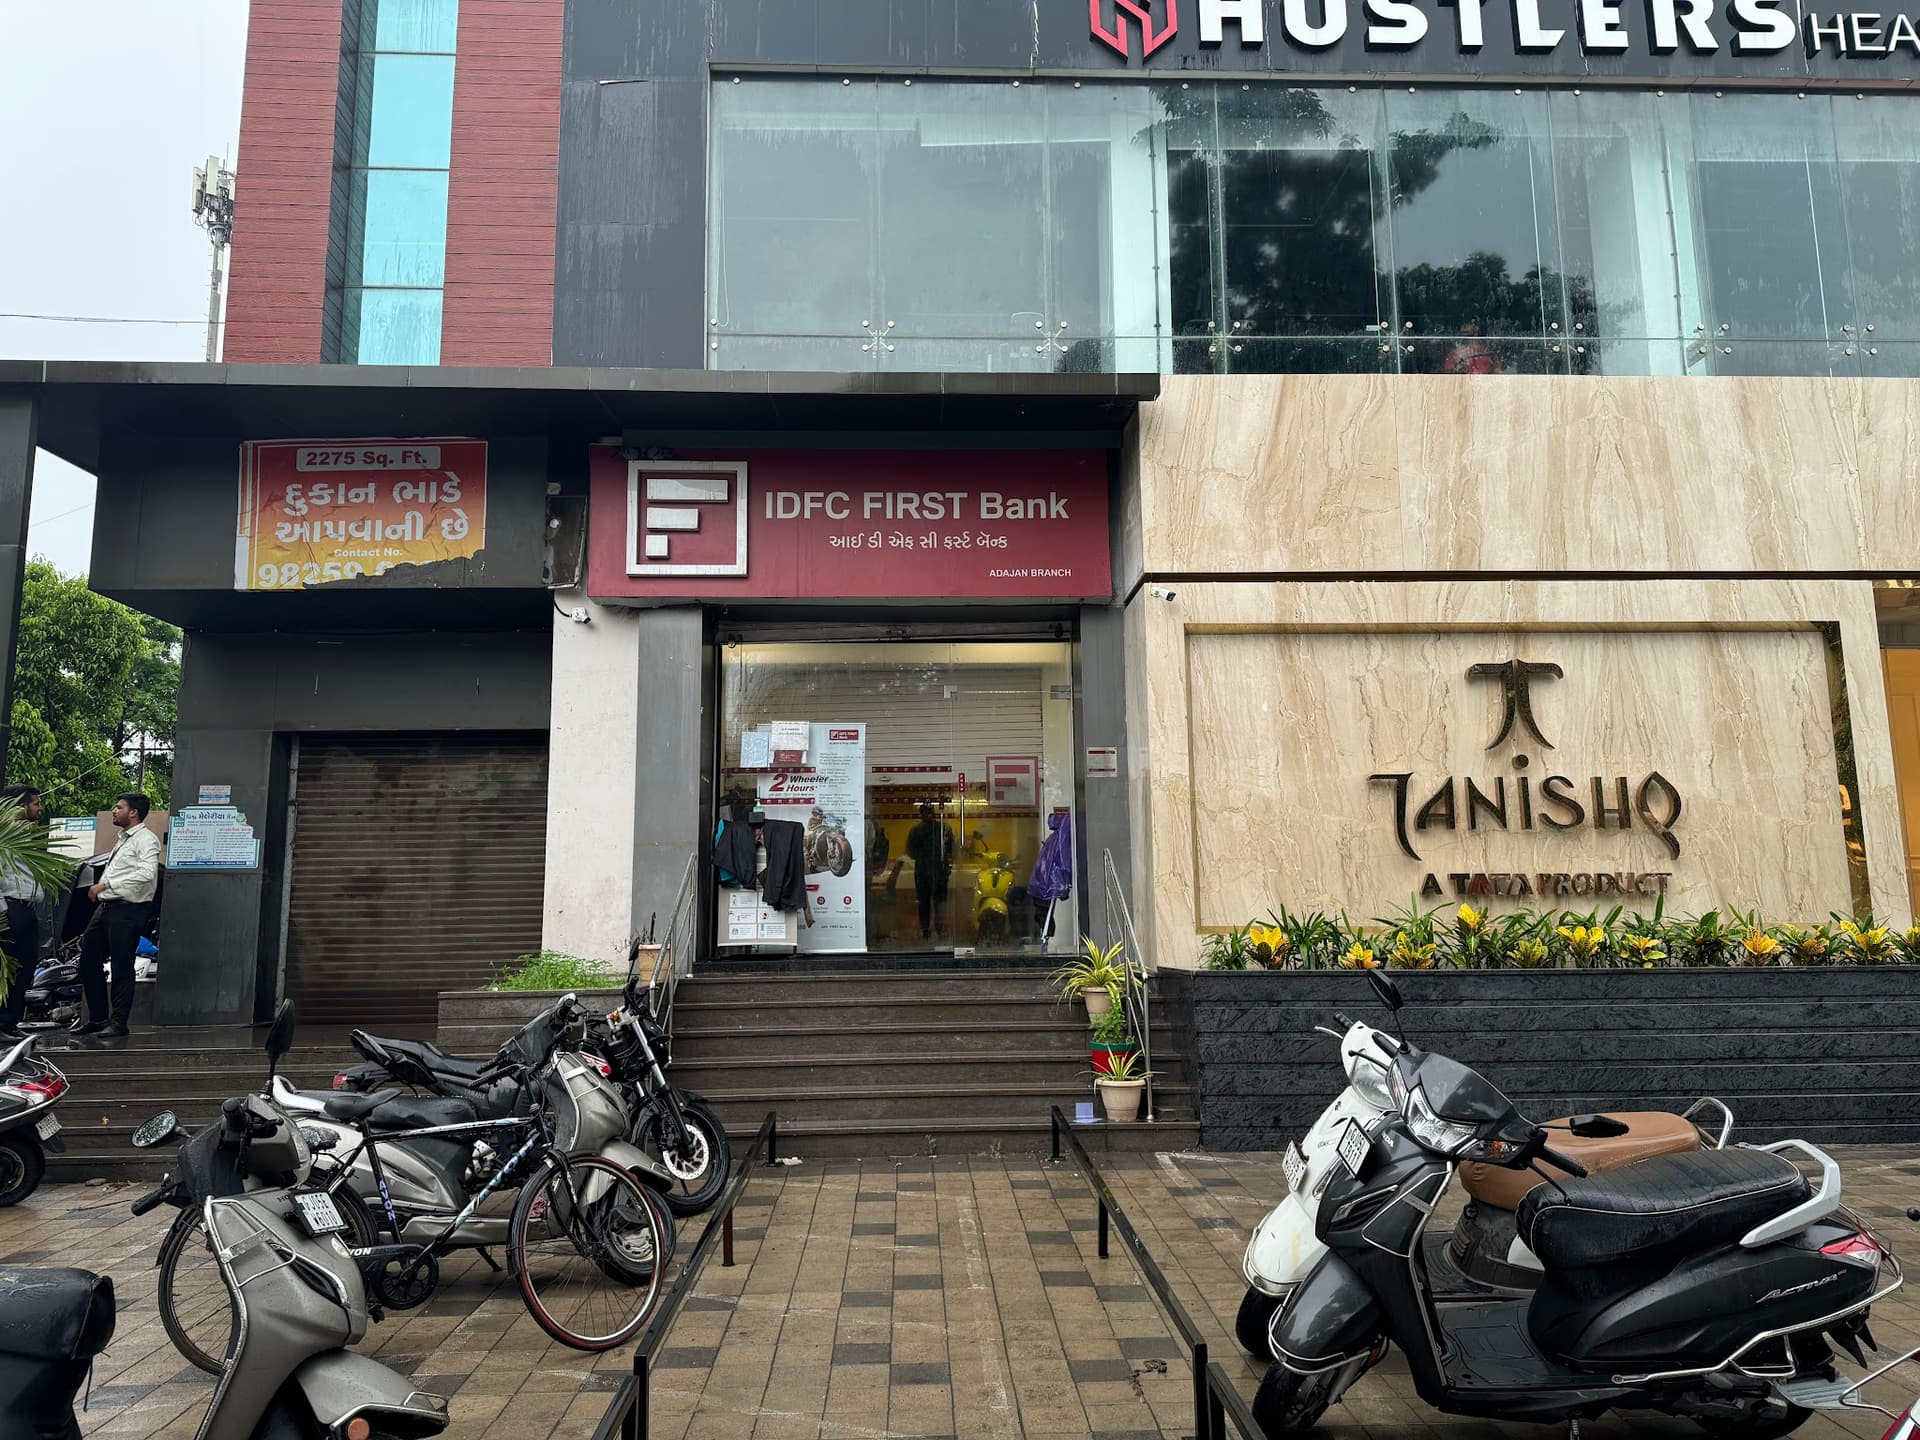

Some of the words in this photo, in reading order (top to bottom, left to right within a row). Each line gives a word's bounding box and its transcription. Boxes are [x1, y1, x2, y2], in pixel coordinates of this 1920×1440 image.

[305, 451, 356, 466] 2275
[361, 451, 395, 469] Sq.
[401, 449, 428, 465] Ft.
[284, 481, 376, 517] દુકાન
[391, 471, 463, 504] ભાડે
[765, 491, 850, 520] IDFC
[863, 491, 968, 520] FIRST
[979, 491, 1069, 520] Bank
[275, 510, 424, 543] આપવાની
[440, 508, 470, 540] છે
[829, 532, 864, 549] આઈ
[867, 530, 883, 549] ડી
[888, 530, 914, 550] એફ
[920, 530, 938, 549] સી
[333, 548, 381, 558] Contact
[383, 547, 403, 556] No.
[258, 561, 364, 588] 98259
[989, 569, 1028, 577] ADAJAN
[1030, 568, 1072, 577] BRANCH
[769, 774, 789, 792] 2
[789, 775, 830, 784] Wheeler
[1420, 873, 1443, 896] A
[1448, 873, 1534, 896] TATA
[1536, 872, 1673, 897] PRODUCT
